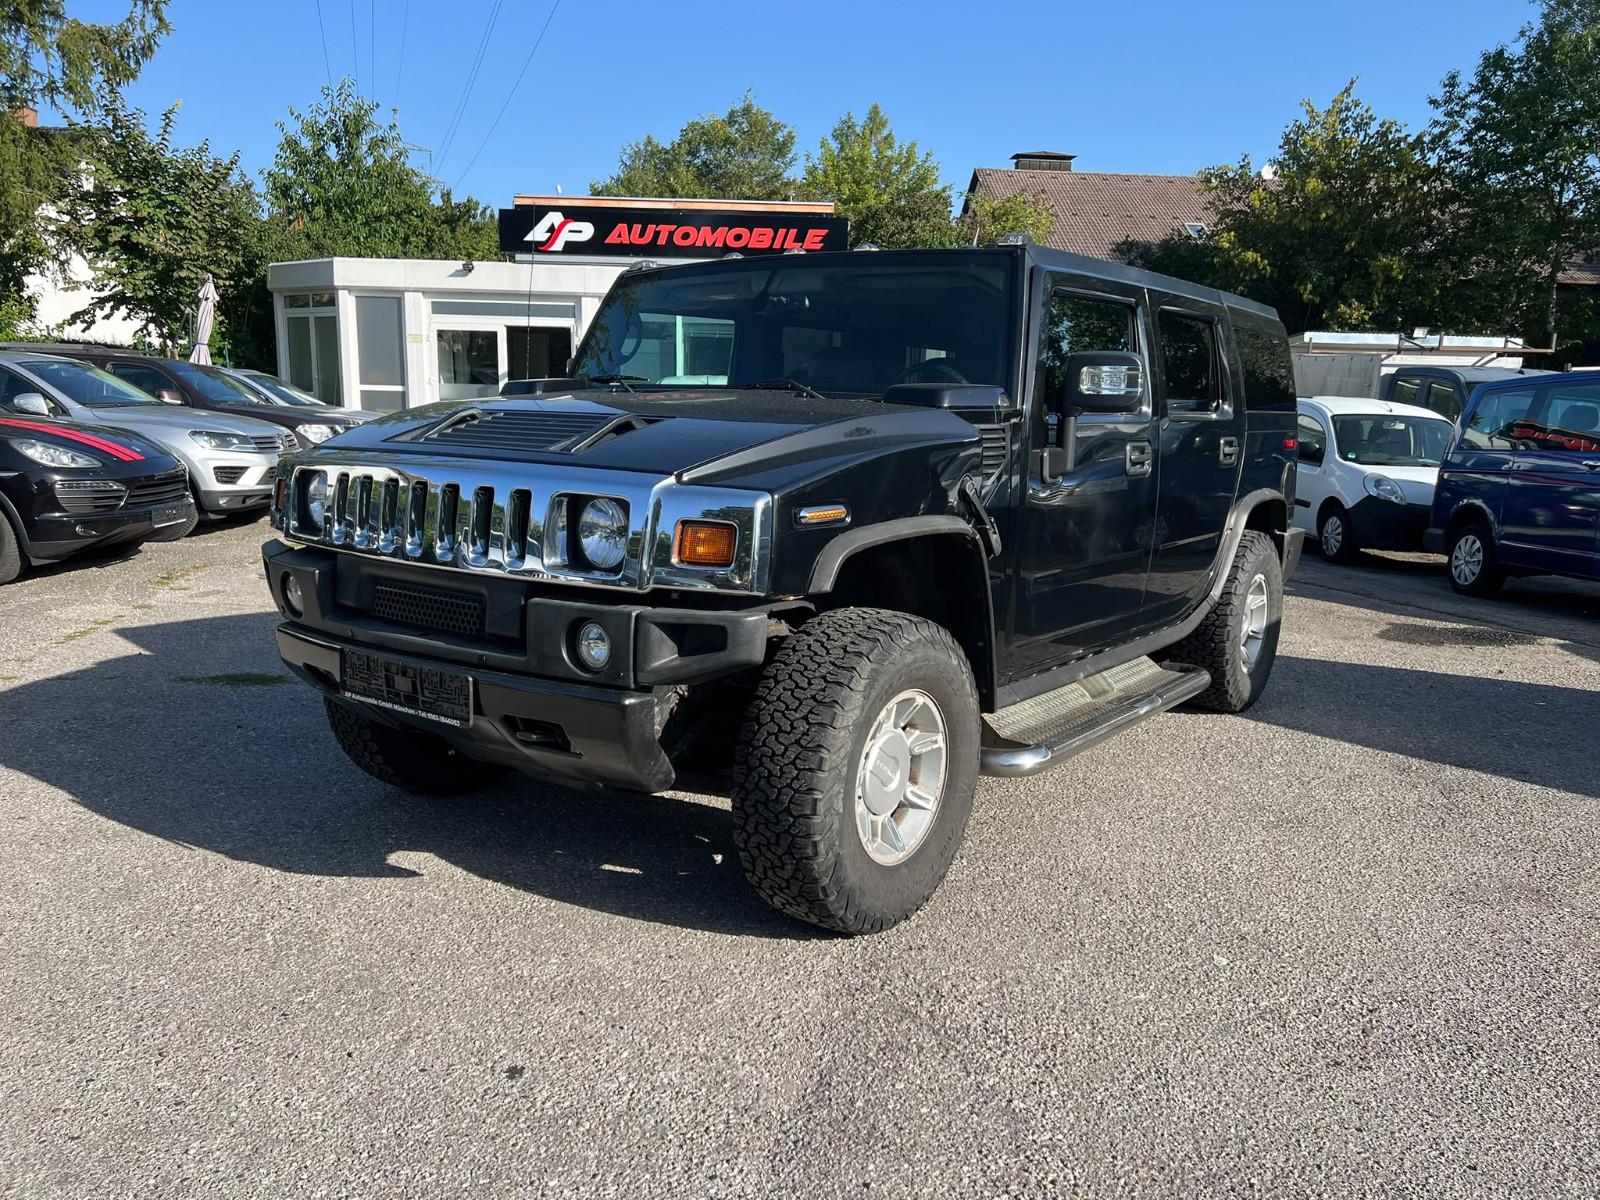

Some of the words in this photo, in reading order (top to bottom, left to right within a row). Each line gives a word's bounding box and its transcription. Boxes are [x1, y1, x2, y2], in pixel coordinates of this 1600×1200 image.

[523, 211, 595, 252] AP
[604, 223, 829, 250] AUTOMOBILE
[352, 692, 378, 705] Automobile
